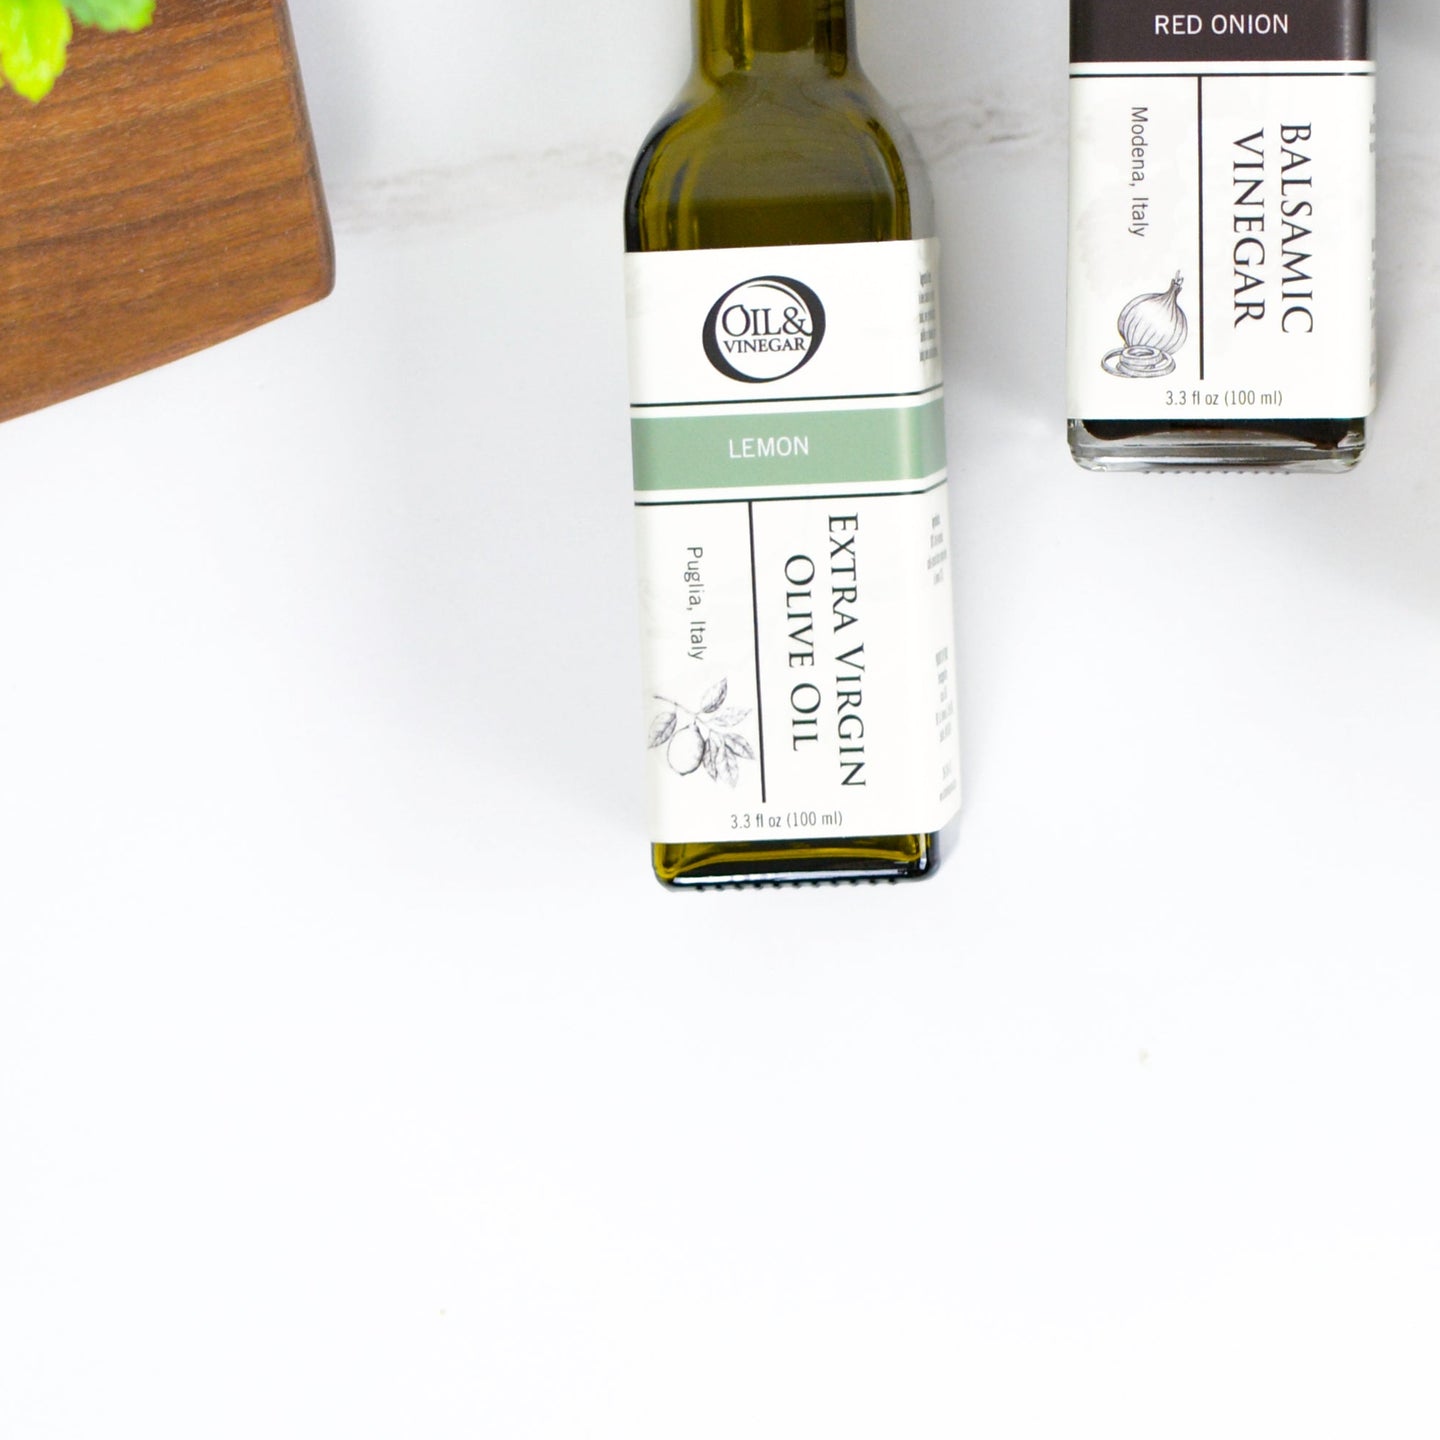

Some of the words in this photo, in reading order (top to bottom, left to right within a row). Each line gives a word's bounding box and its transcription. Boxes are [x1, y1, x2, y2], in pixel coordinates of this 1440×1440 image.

[1154, 14, 1202, 35] RED
[1211, 13, 1290, 35] ONION
[1129, 106, 1149, 187] Modena,
[1128, 197, 1150, 237] Italy
[1233, 126, 1266, 329] VINEGAR
[1280, 121, 1314, 333] BALSAMIC
[721, 304, 814, 338] OIL&
[723, 336, 807, 354] VINEGAR
[1165, 392, 1187, 406] 3.3
[1191, 390, 1201, 405] fl
[1205, 394, 1219, 406] oz
[1224, 390, 1256, 406] (100
[1260, 390, 1283, 406] ml)
[729, 436, 809, 459] LEMON
[684, 547, 703, 613] Puglia,
[828, 512, 859, 634] EXTRA
[784, 554, 816, 668] OLIVE
[688, 620, 708, 661] Italy
[790, 682, 822, 752] OIL
[834, 643, 867, 788] VIRGIN
[730, 814, 752, 830] 3.3
[755, 812, 764, 828] fl
[768, 816, 782, 828] oz
[786, 810, 817, 829] (100
[821, 810, 844, 827] ml)
